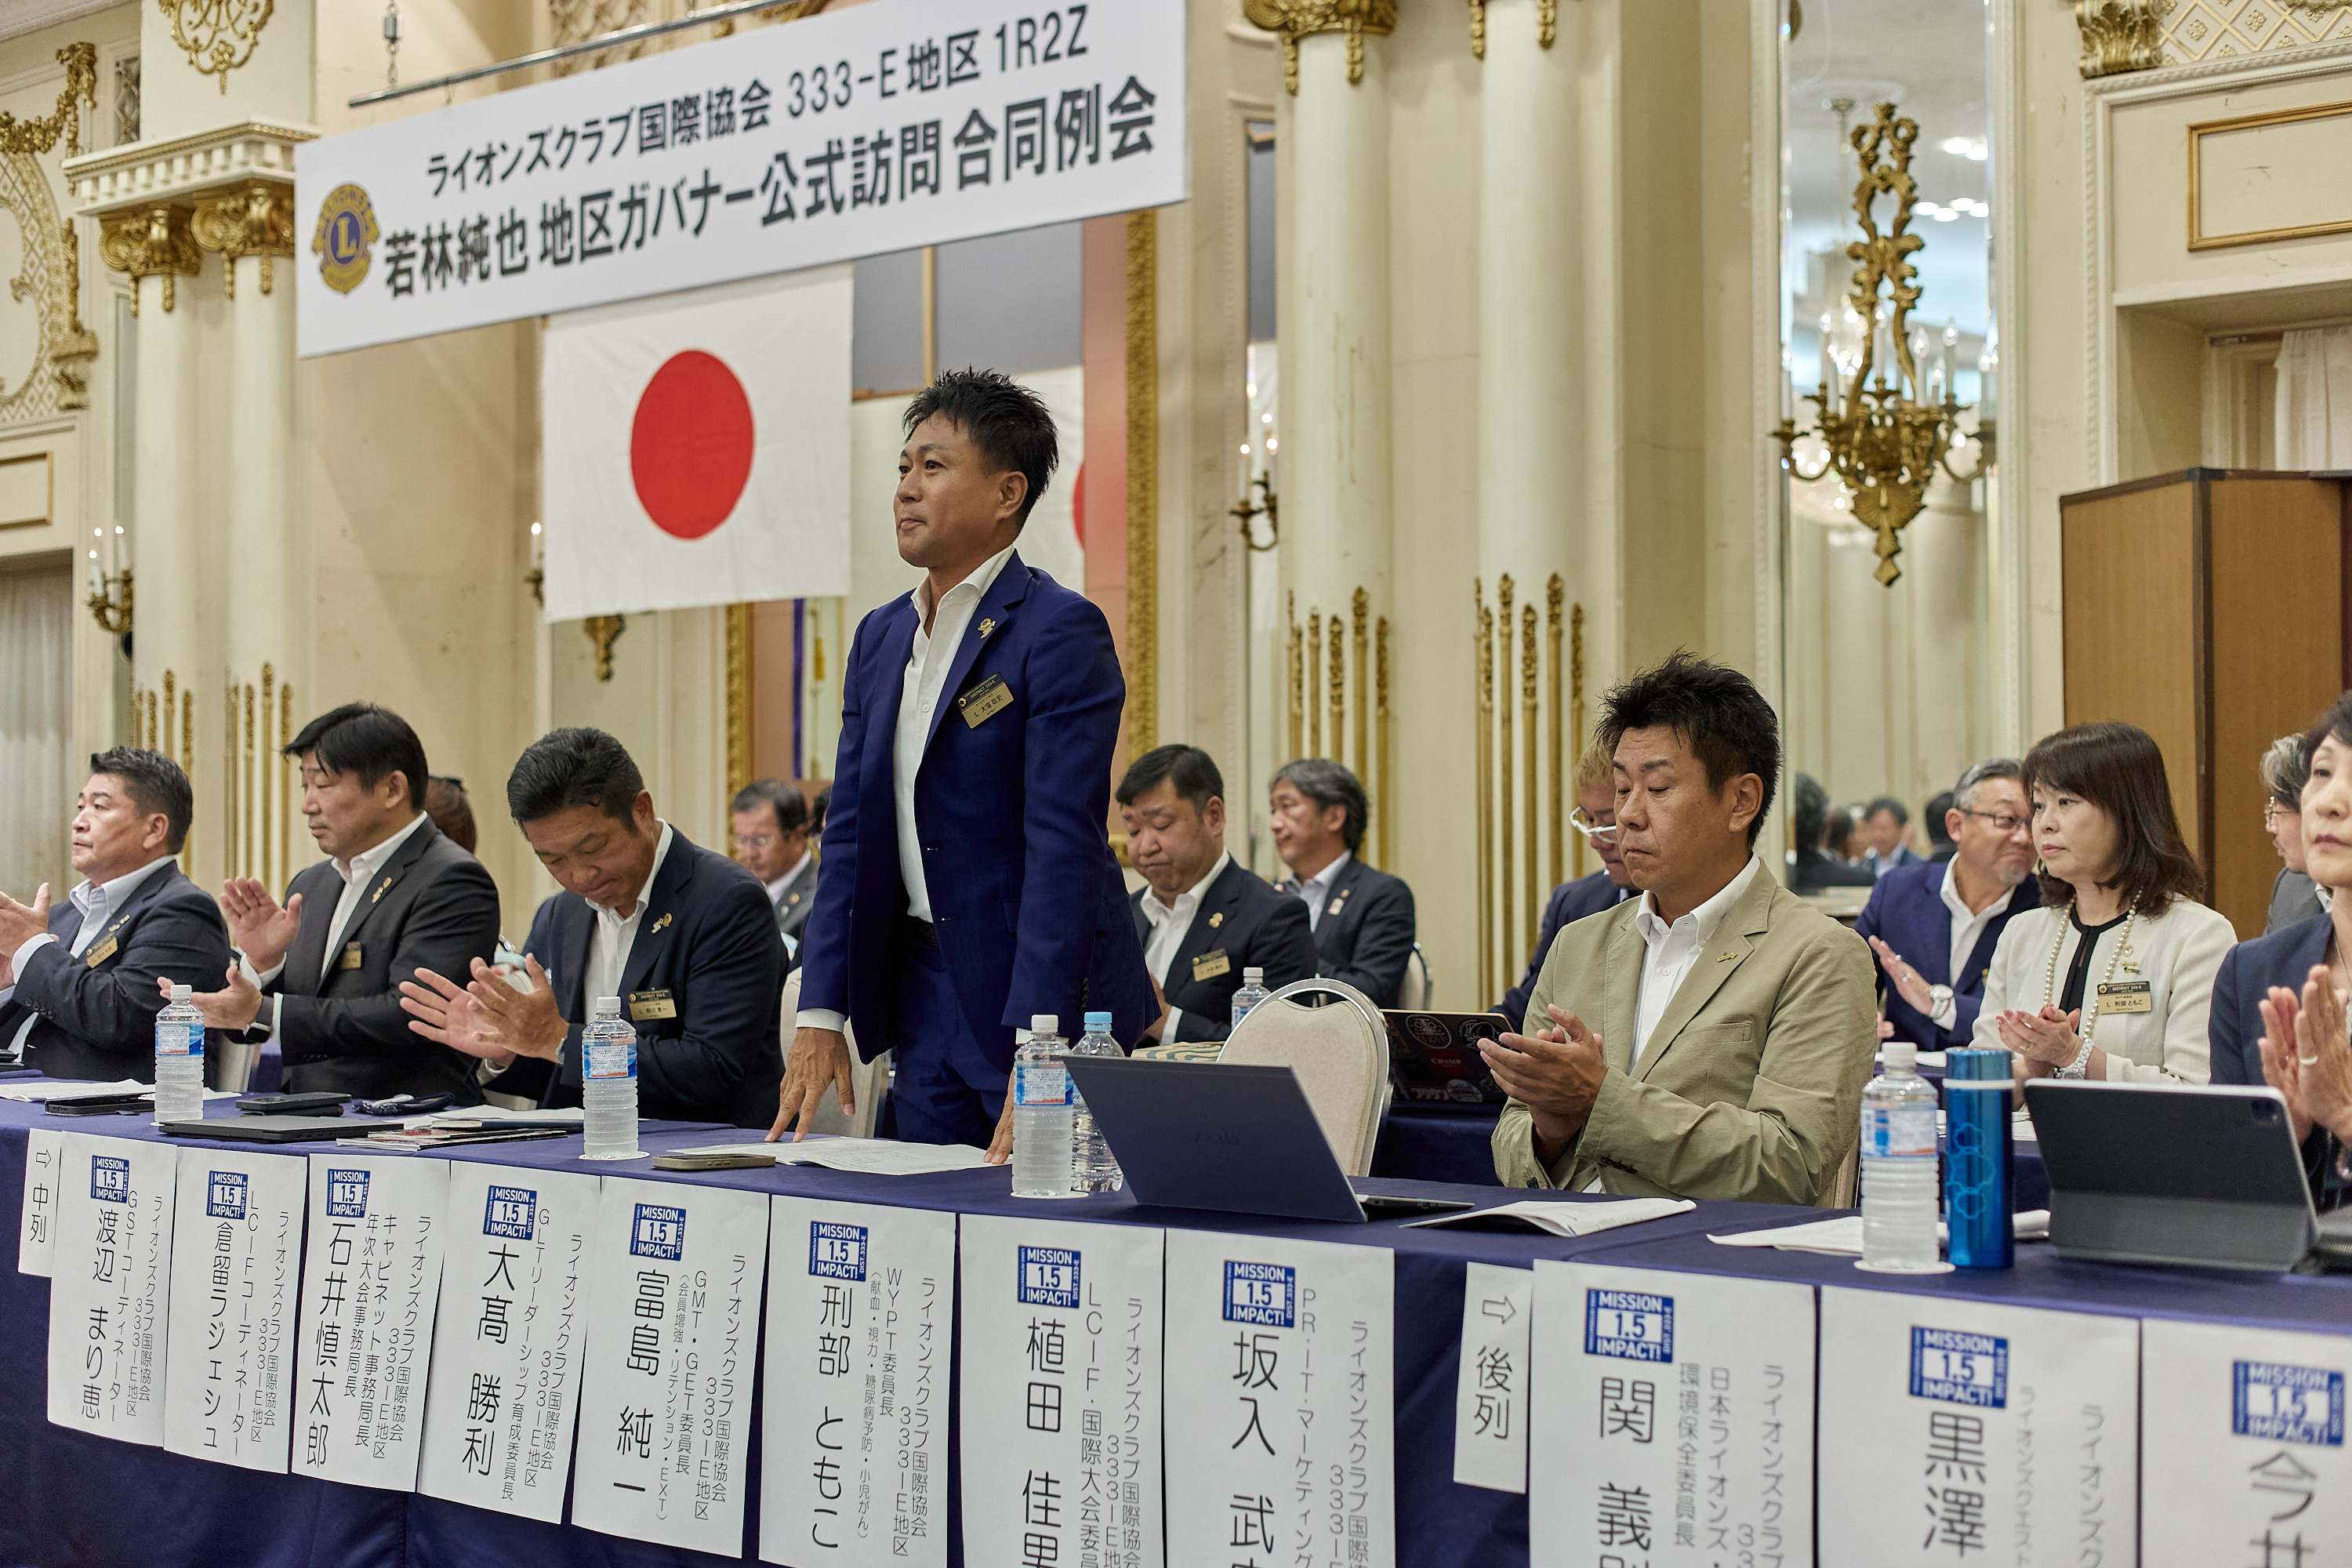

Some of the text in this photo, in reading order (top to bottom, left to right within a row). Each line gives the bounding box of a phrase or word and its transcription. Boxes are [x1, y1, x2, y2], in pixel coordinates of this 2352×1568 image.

[427, 78, 771, 197] ライオンズクラブ国際協会
[994, 4, 1088, 72] 1R2Z
[336, 216, 357, 259] L
[385, 207, 528, 298] 若林純也
[96, 1157, 124, 1170] MISSION
[103, 1171, 117, 1188] 1.5
[214, 1173, 243, 1185] MISSION
[334, 1171, 365, 1182] MISSION
[96, 1188, 122, 1201] IMPACT!
[212, 1204, 240, 1218] IMPACT!
[220, 1186, 234, 1204] 1.5
[332, 1203, 361, 1216] IMPACT!
[341, 1185, 355, 1202] 1.5
[495, 1188, 530, 1203] MISSION
[30, 1183, 49, 1243] 中列
[490, 1222, 527, 1238] IMPACT!
[503, 1203, 519, 1222] 1.5
[641, 1206, 679, 1221] MISSION
[649, 1221, 667, 1242] 1.5
[818, 1224, 860, 1240] MISSION
[637, 1242, 675, 1258] IMPACT!
[829, 1240, 848, 1261] 1.5
[1027, 1248, 1073, 1265] MISSION
[817, 1261, 858, 1279] IMPACT!
[1038, 1265, 1061, 1288] 1.5
[1234, 1263, 1286, 1282] MISSION
[111, 1190, 138, 1422] GSTコーディネーター
[138, 1196, 163, 1403] ライオンズクラブ国際協会
[343, 1213, 379, 1398] 年次大会事務局長
[1027, 1288, 1071, 1306] IMPACT!
[1247, 1282, 1272, 1306] 1.5
[1599, 1290, 1662, 1313] MISSION
[81, 1208, 118, 1420] 渡辺 まり恵
[232, 1192, 259, 1456] LCIFコーディネーター
[263, 1211, 289, 1427] ライオンズクラブ国際協会
[355, 1214, 397, 1447] キャビネット事務局長
[389, 1215, 431, 1443] ライオンズクラブ国際協会
[1232, 1306, 1284, 1326] IMPACT!
[1616, 1312, 1645, 1338] 1.5
[203, 1221, 234, 1448] 倉留ラジェシュ
[307, 1222, 356, 1468] 石井慎太郎
[879, 1267, 902, 1417] WYPT委員長
[1596, 1338, 1661, 1361] IMPACT!
[1924, 1330, 1994, 1354] MISSION
[501, 1208, 550, 1501] GLTリーダーシップ育成委員長
[539, 1234, 583, 1471] ライオンズクラブ国際協会
[1944, 1354, 1974, 1381] 1.5
[613, 1269, 670, 1493] 富島 純一
[712, 1254, 746, 1503] ライオンズクラブ国際協会
[1026, 1316, 1067, 1433] 植田
[910, 1277, 936, 1538] ライオンズクラブ国際協会
[1473, 1345, 1514, 1441] 後列
[1923, 1381, 1992, 1406] IMPACT!
[461, 1372, 502, 1476] 勝利
[811, 1284, 853, 1549] 刑部 ともこ
[1122, 1298, 1142, 1568] ライオンズクラブ国際協会
[1229, 1330, 1279, 1568] 坂入 武
[1348, 1320, 1369, 1568] ライオンズクラブ国際
[1674, 1361, 1701, 1549] 環境保全委員長
[1597, 1377, 1656, 1568] 関 義
[1923, 1410, 1987, 1559] 黒澤
